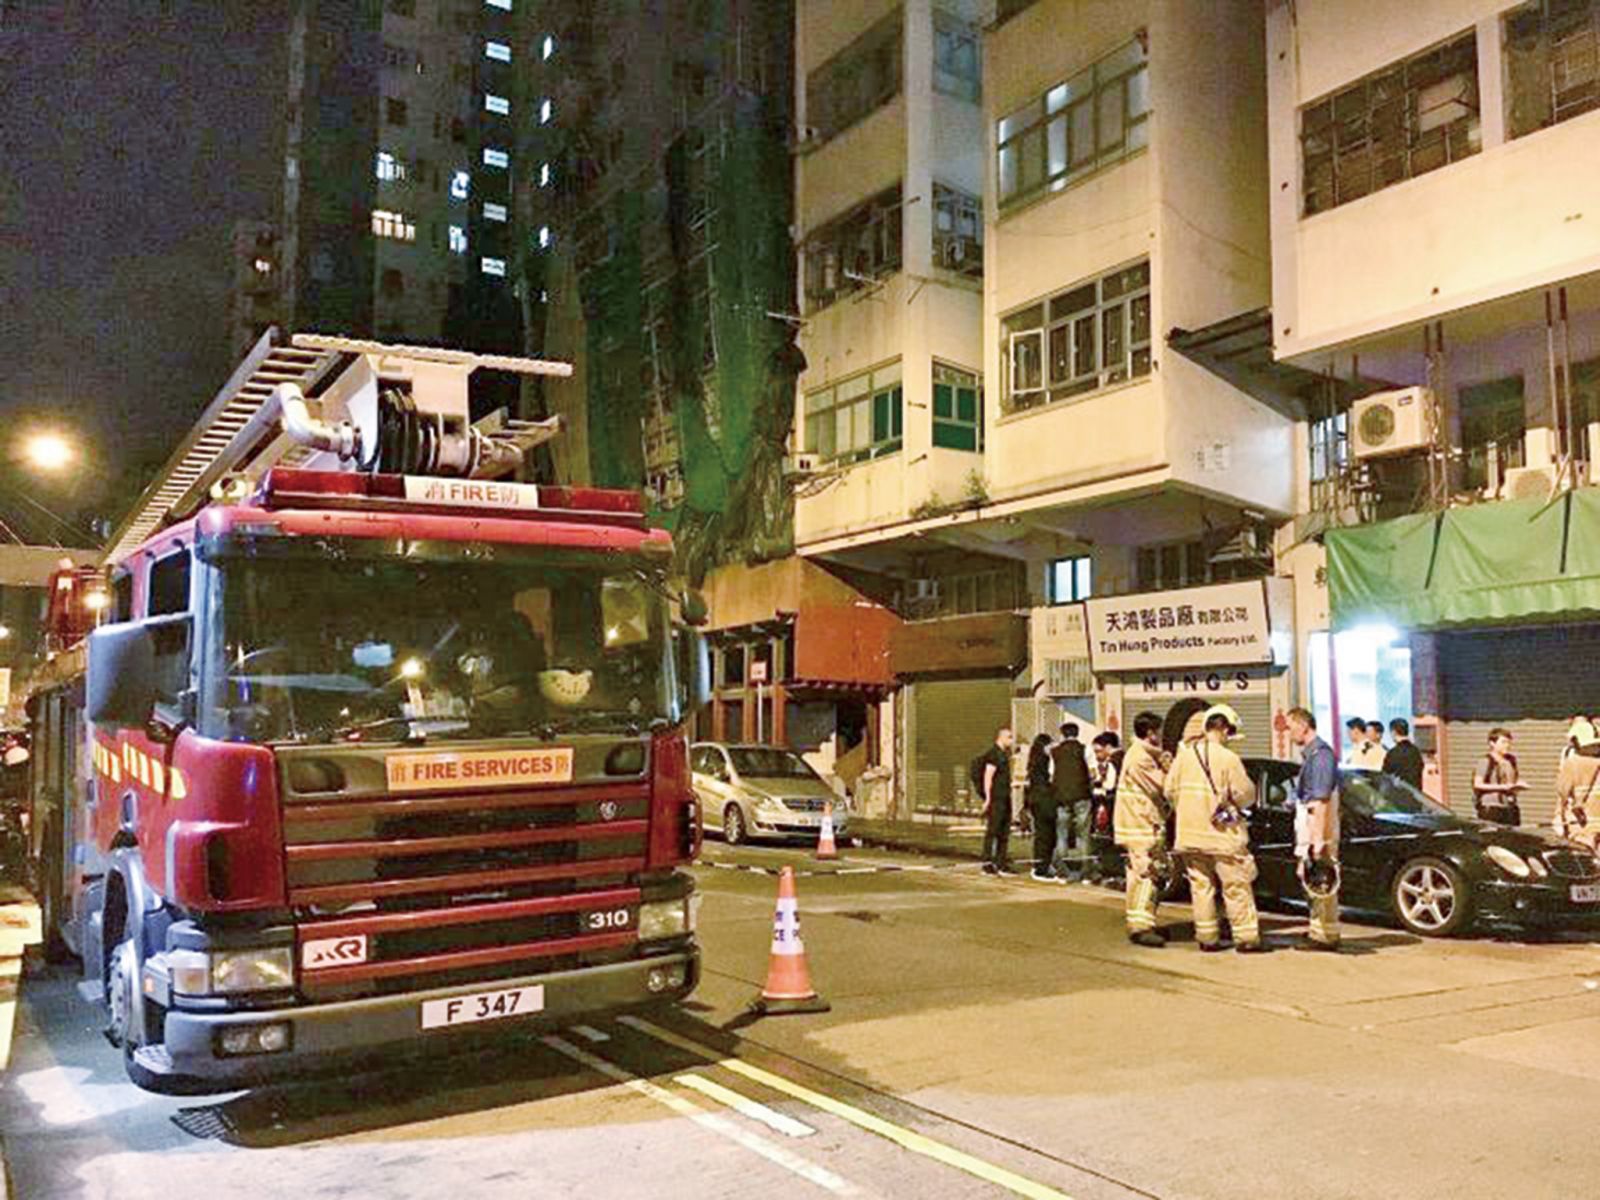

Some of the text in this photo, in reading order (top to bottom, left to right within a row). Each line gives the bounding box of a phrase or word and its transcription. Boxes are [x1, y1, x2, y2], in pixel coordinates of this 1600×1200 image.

[450, 483, 499, 502] FIRE
[1100, 641, 1117, 653] Tin
[1119, 640, 1149, 653] Hung
[1151, 636, 1205, 650] Products
[413, 761, 457, 780] FIRE
[462, 756, 553, 778] SERVICES
[589, 909, 629, 928] 310
[447, 991, 522, 1022] F 347
